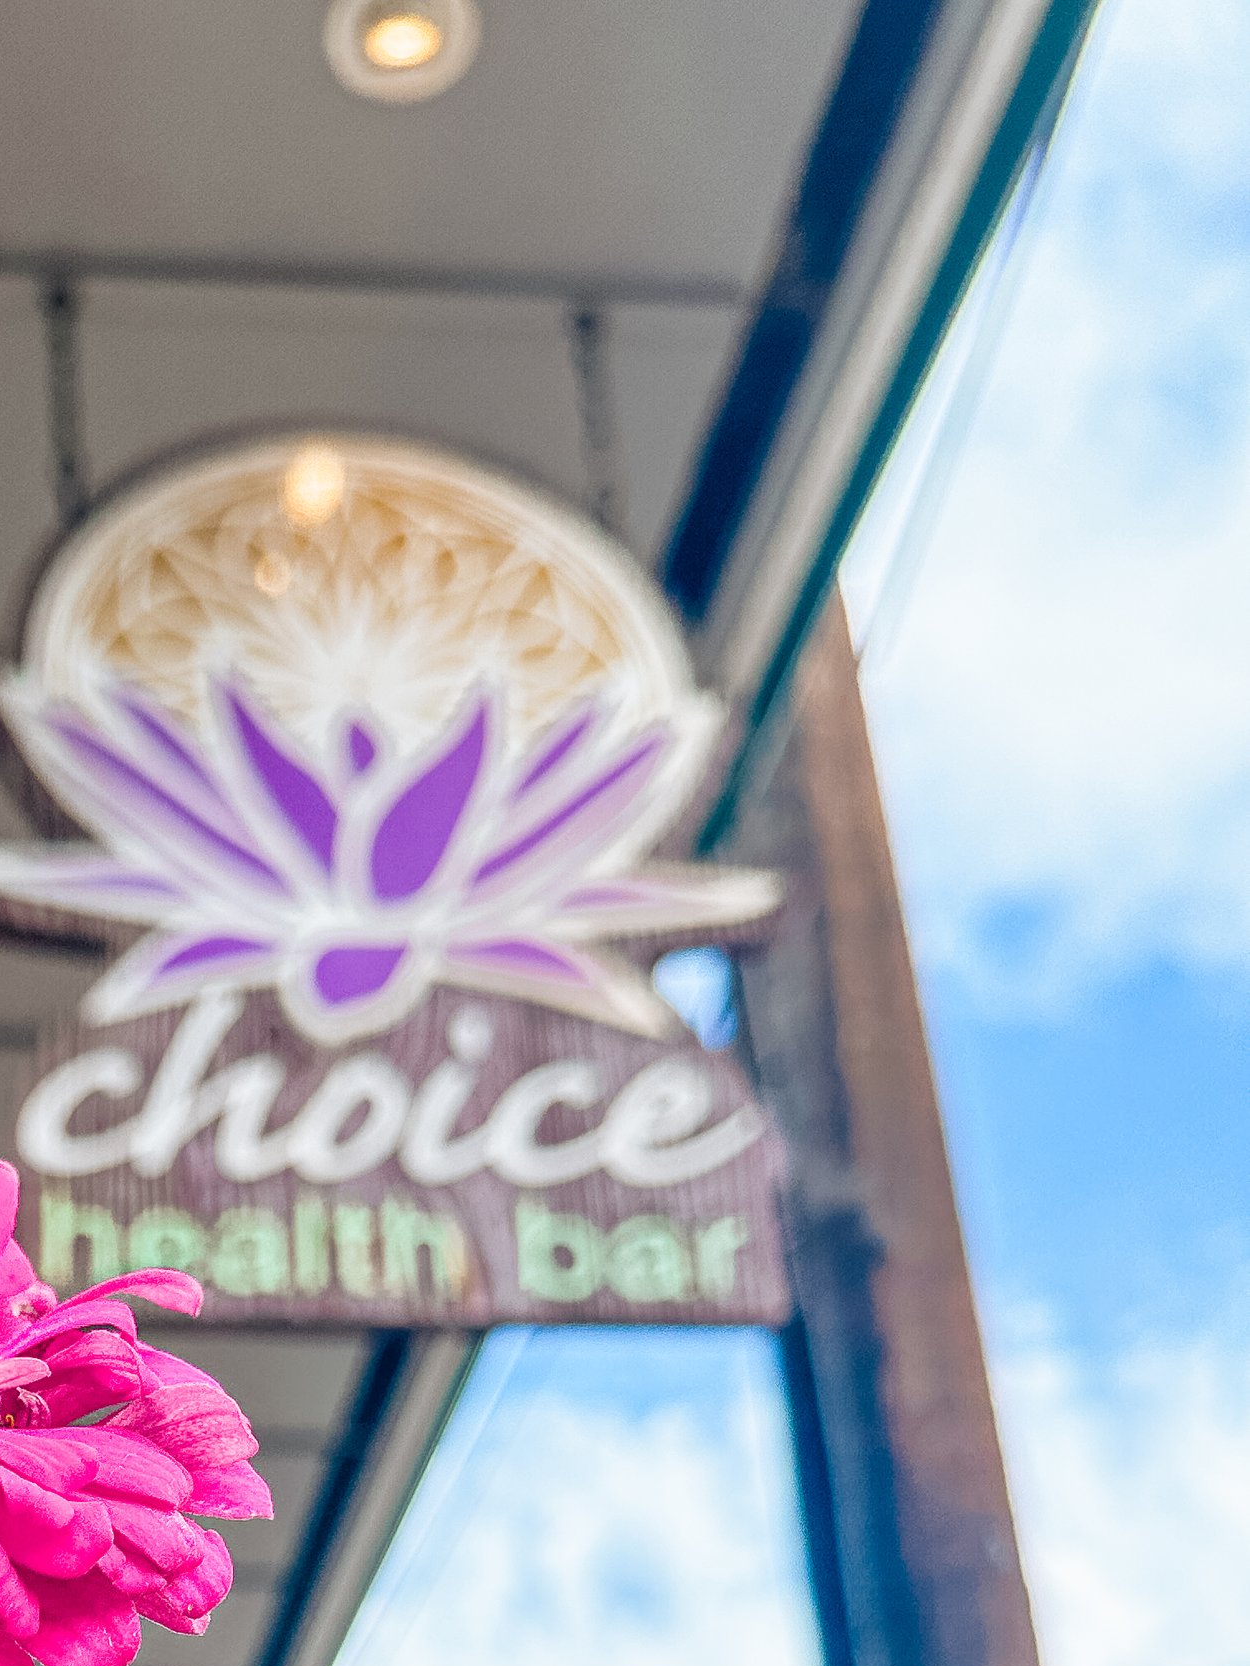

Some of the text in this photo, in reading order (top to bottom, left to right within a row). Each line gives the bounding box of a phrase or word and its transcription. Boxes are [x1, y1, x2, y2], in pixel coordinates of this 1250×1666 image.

[17, 986, 765, 1187] choice
[40, 1190, 750, 1303] health bar
